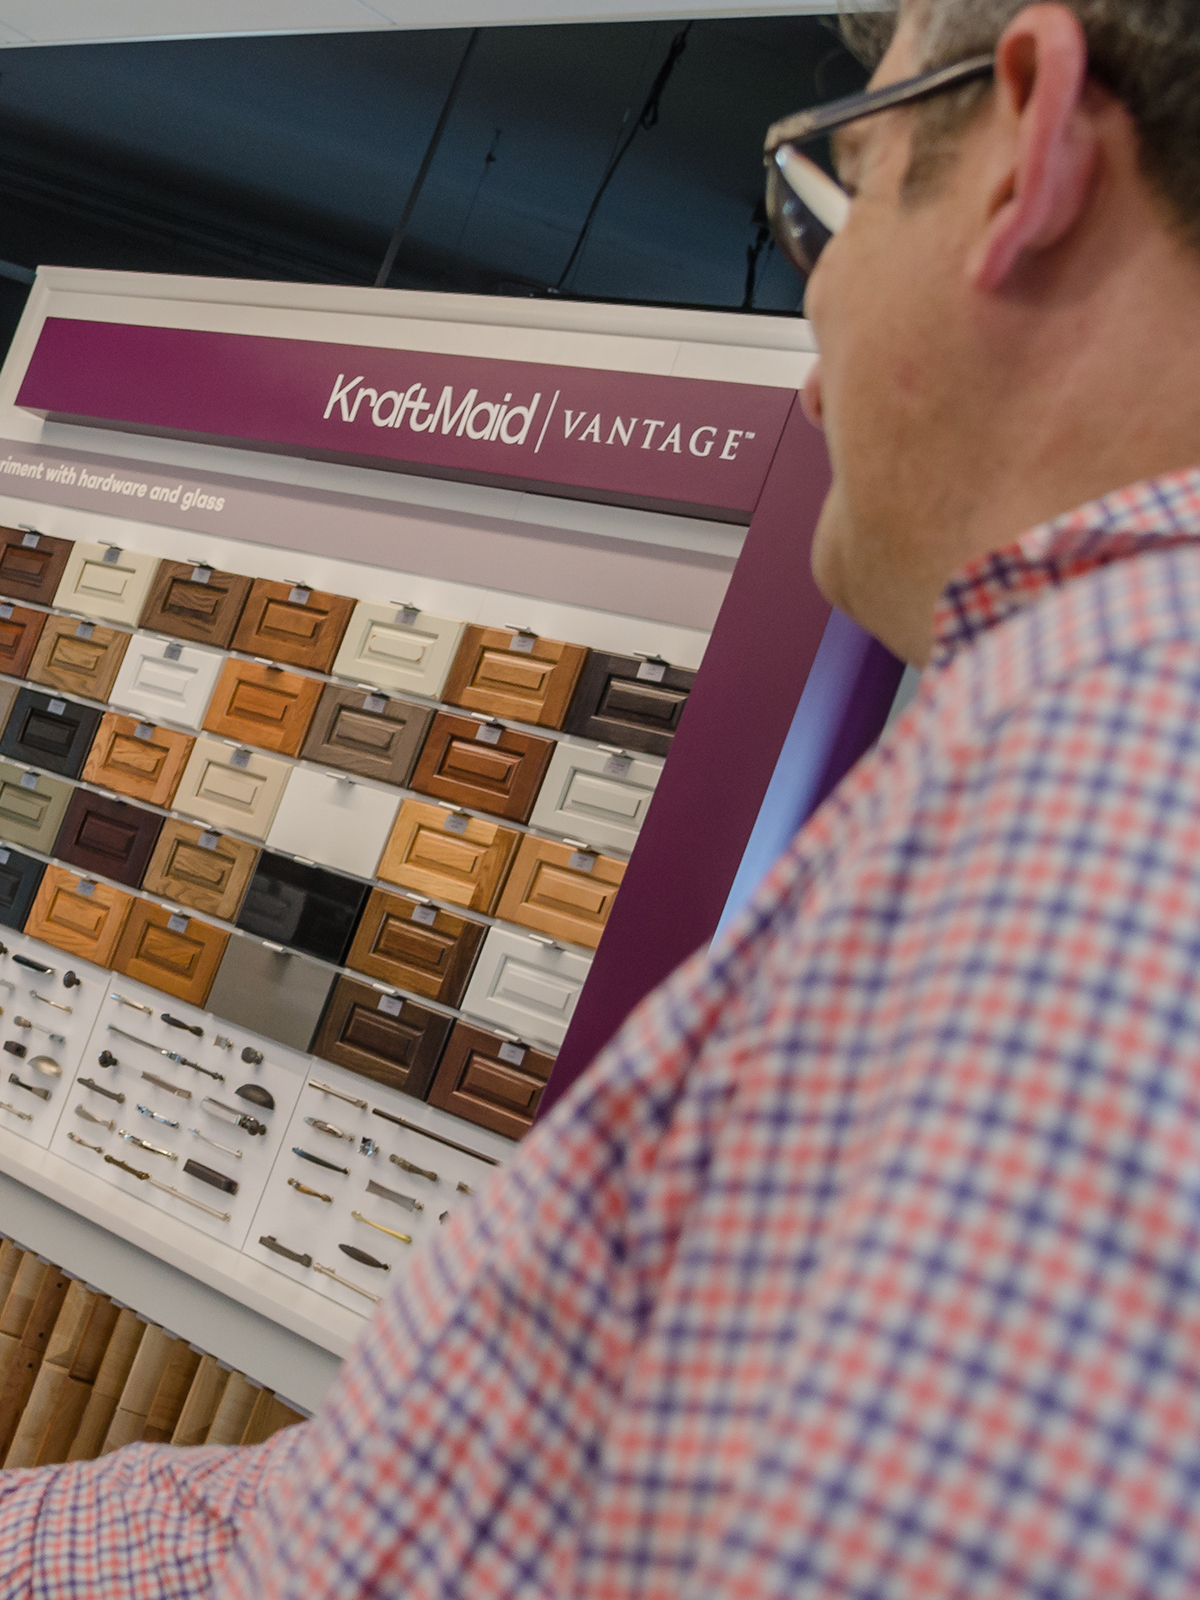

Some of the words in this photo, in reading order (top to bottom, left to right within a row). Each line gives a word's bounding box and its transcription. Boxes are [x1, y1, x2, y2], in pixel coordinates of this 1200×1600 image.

[323, 374, 542, 445] KraftMaid
[46, 465, 77, 485] with
[78, 470, 147, 497] hardware
[150, 485, 181, 503] and
[181, 489, 225, 512] glass
